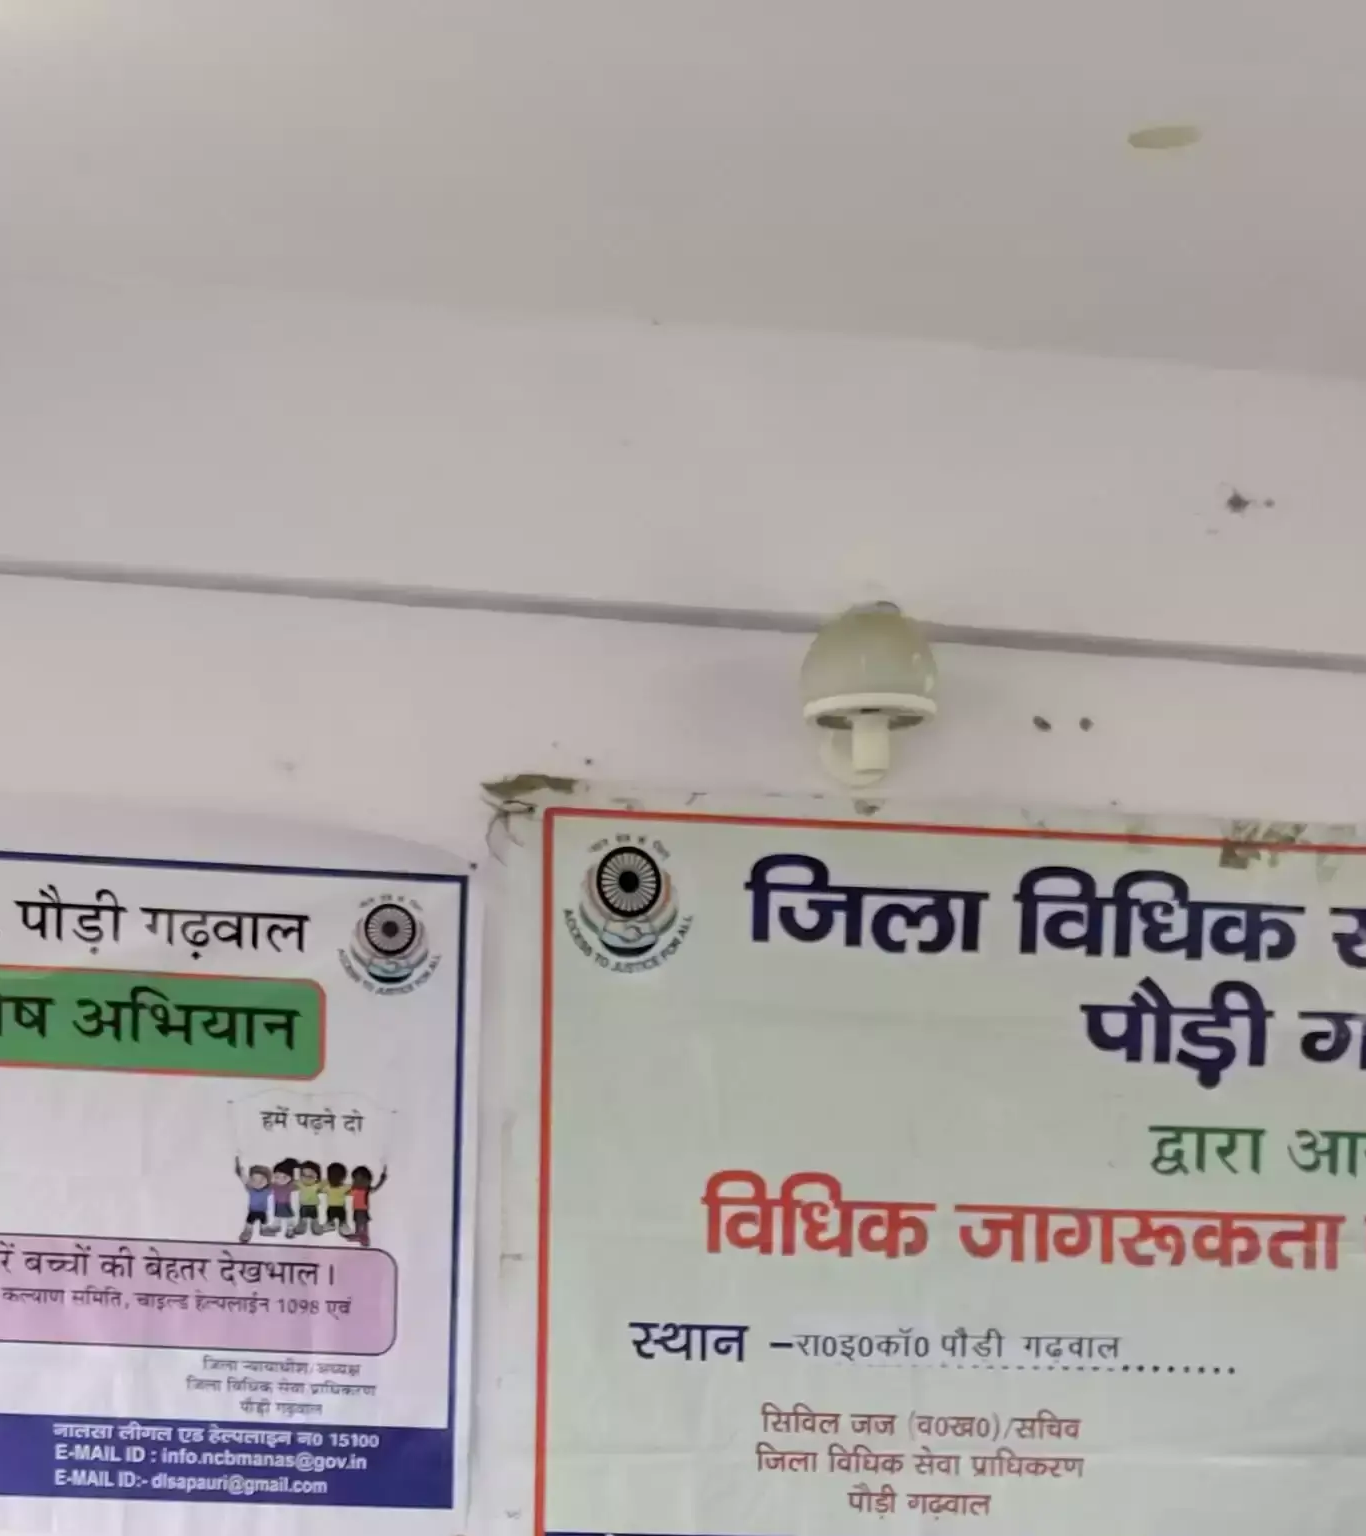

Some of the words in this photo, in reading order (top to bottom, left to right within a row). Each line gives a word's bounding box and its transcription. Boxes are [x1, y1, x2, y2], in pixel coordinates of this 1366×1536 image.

[14, 885, 127, 954] पौड़ी
[142, 905, 310, 960] गढ़वाल
[744, 853, 990, 954] जिला
[1013, 865, 1306, 962] विधिक
[72, 985, 300, 1051] अभियान
[1079, 976, 1275, 1090] पौड़ी
[260, 1105, 290, 1131] हमें
[342, 1108, 366, 1133] दो
[1148, 1124, 1266, 1178] द्वारा
[701, 1169, 937, 1260] विधिक
[954, 1203, 1346, 1271] जागरूकता
[23, 1243, 91, 1276] बच्चों
[99, 1246, 135, 1280] की
[143, 1247, 211, 1284] बेहतर
[278, 1297, 320, 1316] 1098
[628, 1322, 750, 1364] स्थान
[52, 1422, 114, 1441] नालसा
[118, 1420, 173, 1443] लीगल
[178, 1426, 205, 1444] एड
[329, 1431, 380, 1449] 15100
[761, 1401, 842, 1435] सिविल
[851, 1413, 898, 1437] जज
[54, 1468, 116, 1488] E-MAIL
[55, 1443, 122, 1463] E-MAIL
[125, 1445, 147, 1464] ID
[161, 1447, 368, 1473] info.ncbmanas@gov.in
[755, 1441, 818, 1474] जिला
[828, 1442, 905, 1475] विधिक
[914, 1445, 961, 1478] सेवा
[970, 1446, 1085, 1479] प्राधिकरण
[847, 1481, 898, 1520] पौड़ी
[907, 1494, 992, 1522] गढ़वाल
